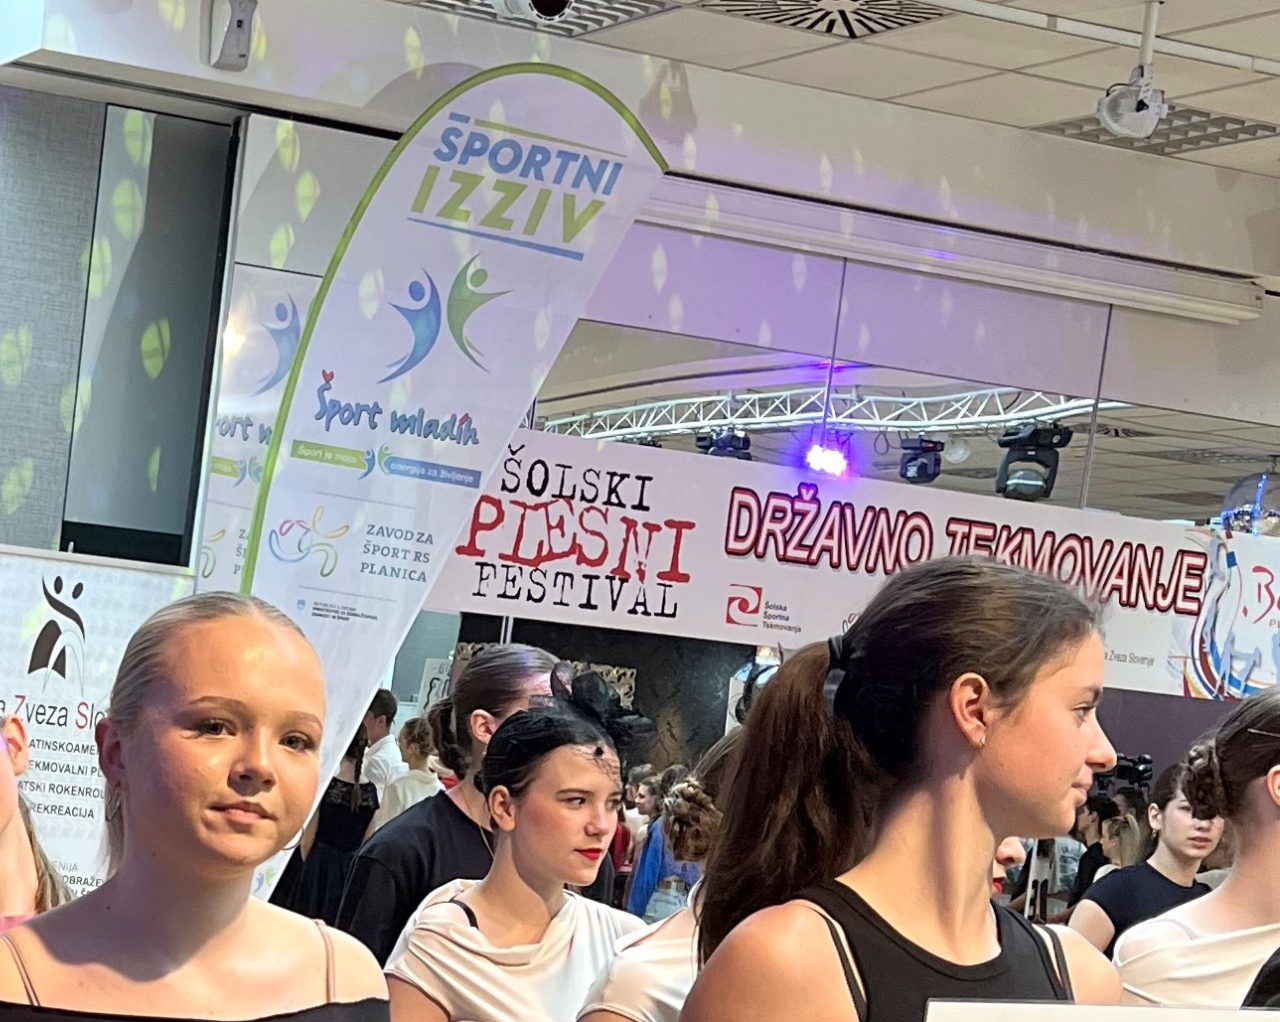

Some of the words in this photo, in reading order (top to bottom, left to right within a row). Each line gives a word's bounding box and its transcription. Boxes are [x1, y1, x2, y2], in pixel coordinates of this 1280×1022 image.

[410, 164, 606, 244] IZZIV
[500, 443, 654, 512] ŠOLSKI
[366, 524, 414, 542] ZAVOD
[416, 530, 434, 545] ZA
[455, 494, 696, 583] PLESNI
[724, 481, 933, 576] DRŽAVNO
[363, 540, 412, 560] ŠPORT
[413, 551, 431, 564] RS
[359, 562, 428, 583] PLANICA
[472, 561, 678, 618] FESTIVAL
[28, 739, 99, 756] ATINSKOAME
[29, 760, 88, 776] EKMOVALNI
